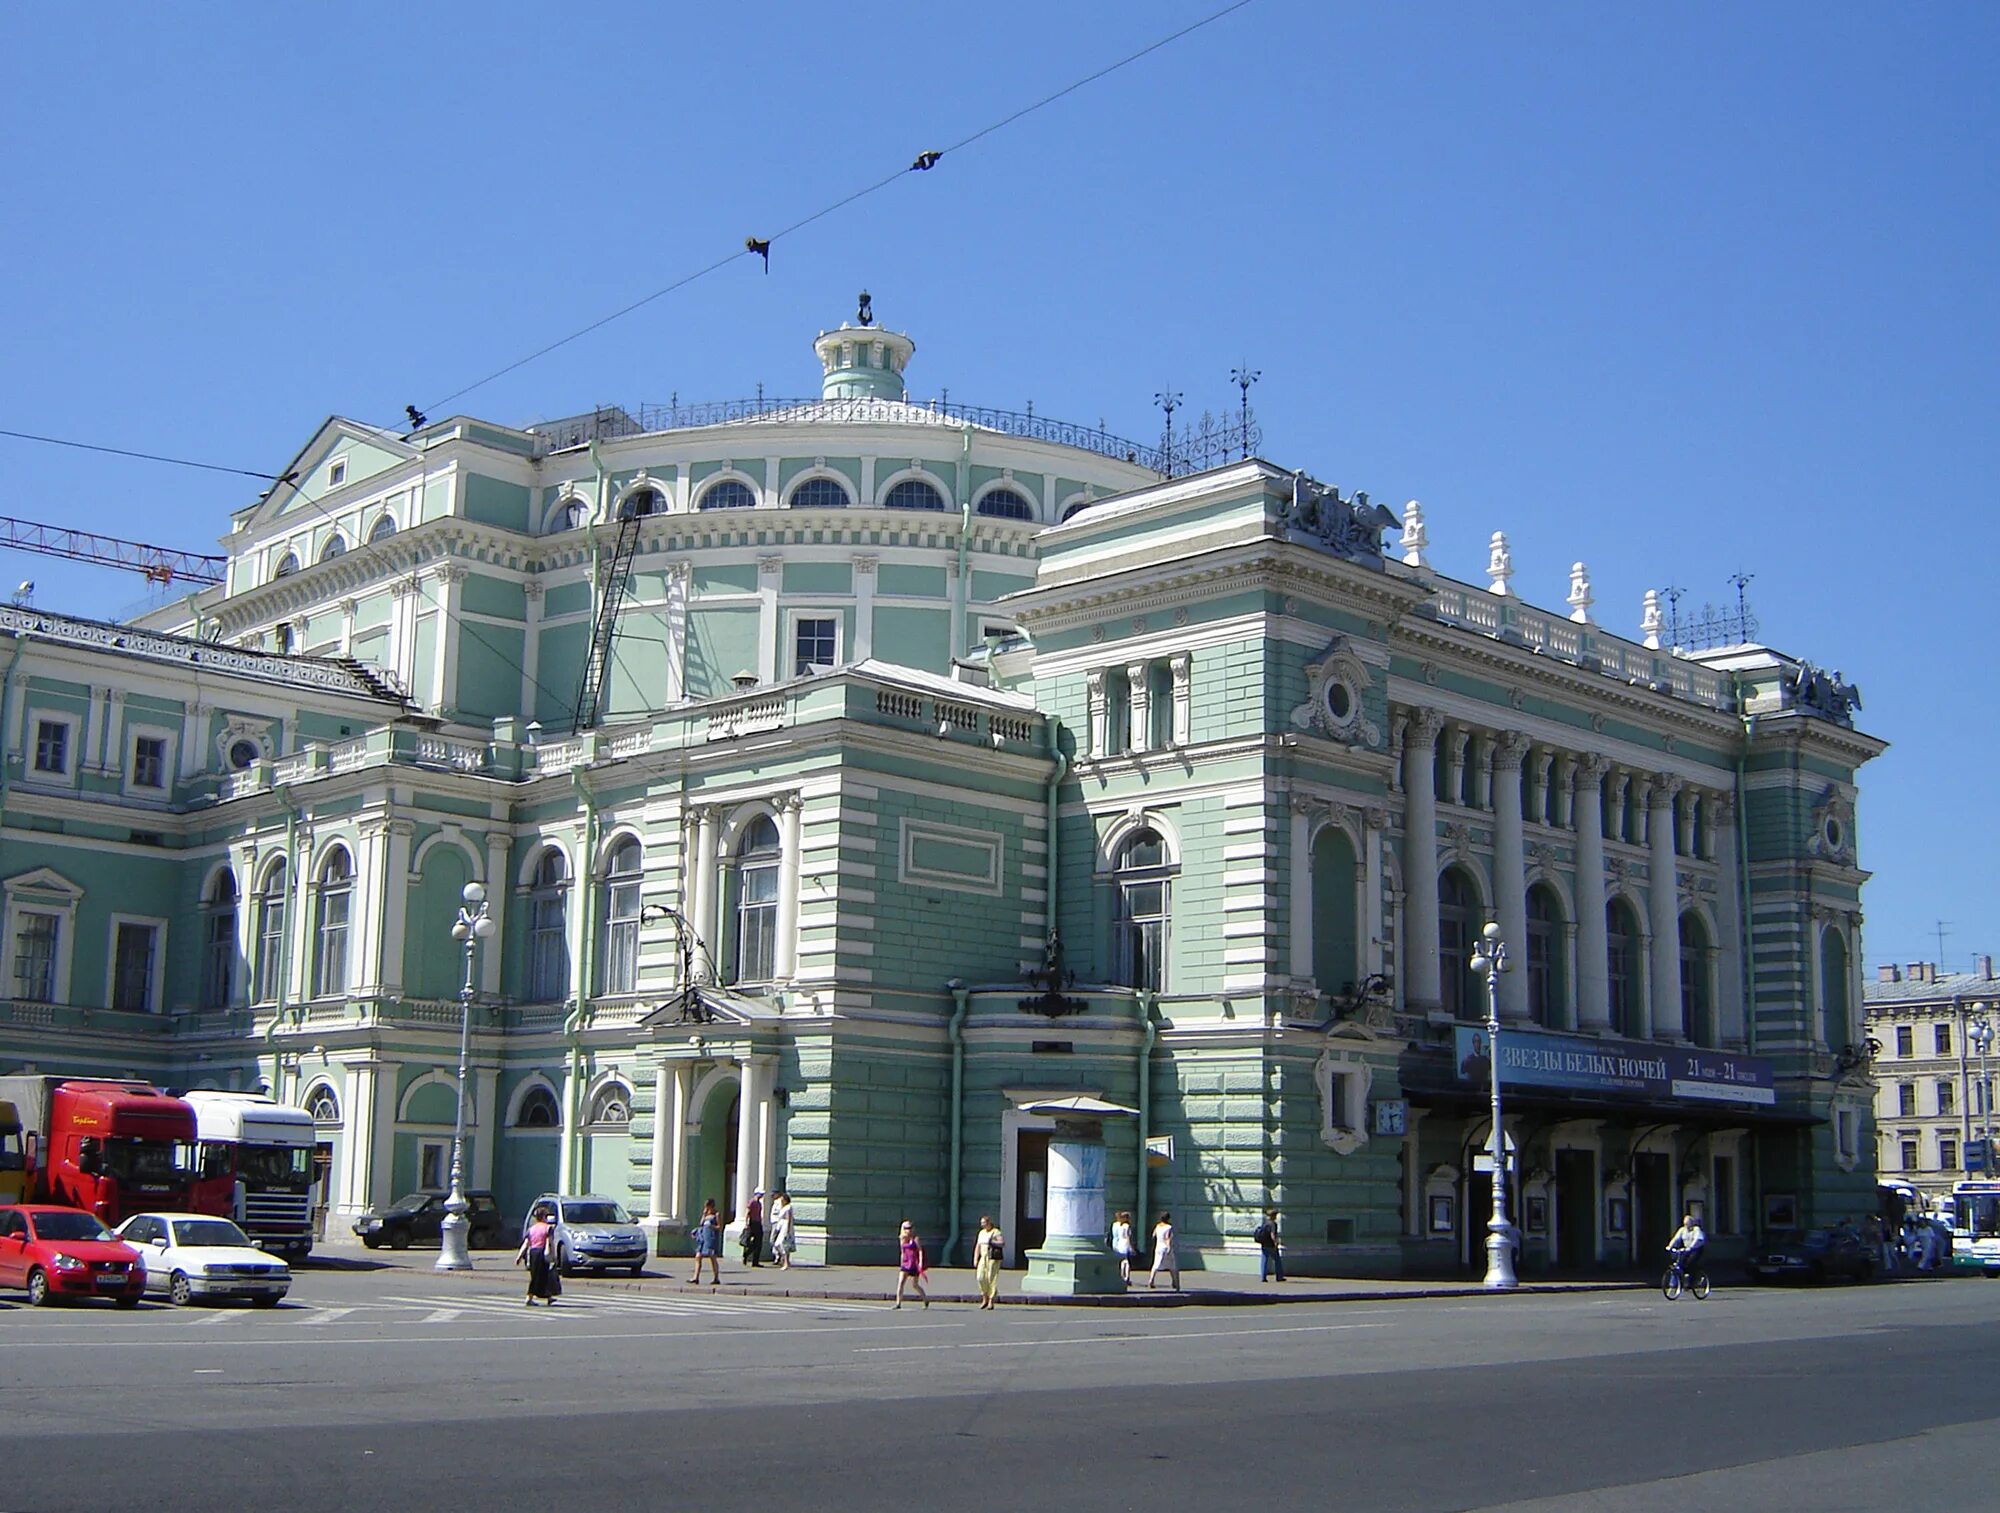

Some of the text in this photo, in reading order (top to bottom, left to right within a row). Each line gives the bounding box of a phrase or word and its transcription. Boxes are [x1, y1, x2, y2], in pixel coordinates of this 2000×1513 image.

[1502, 1047, 1562, 1072] ЗВЕЗДЫ
[1566, 1053, 1615, 1076] БЕЛЫХ
[1617, 1056, 1667, 1080] НОЧЕЙ
[1688, 1058, 1699, 1077] 21
[1723, 1062, 1736, 1080] 21
